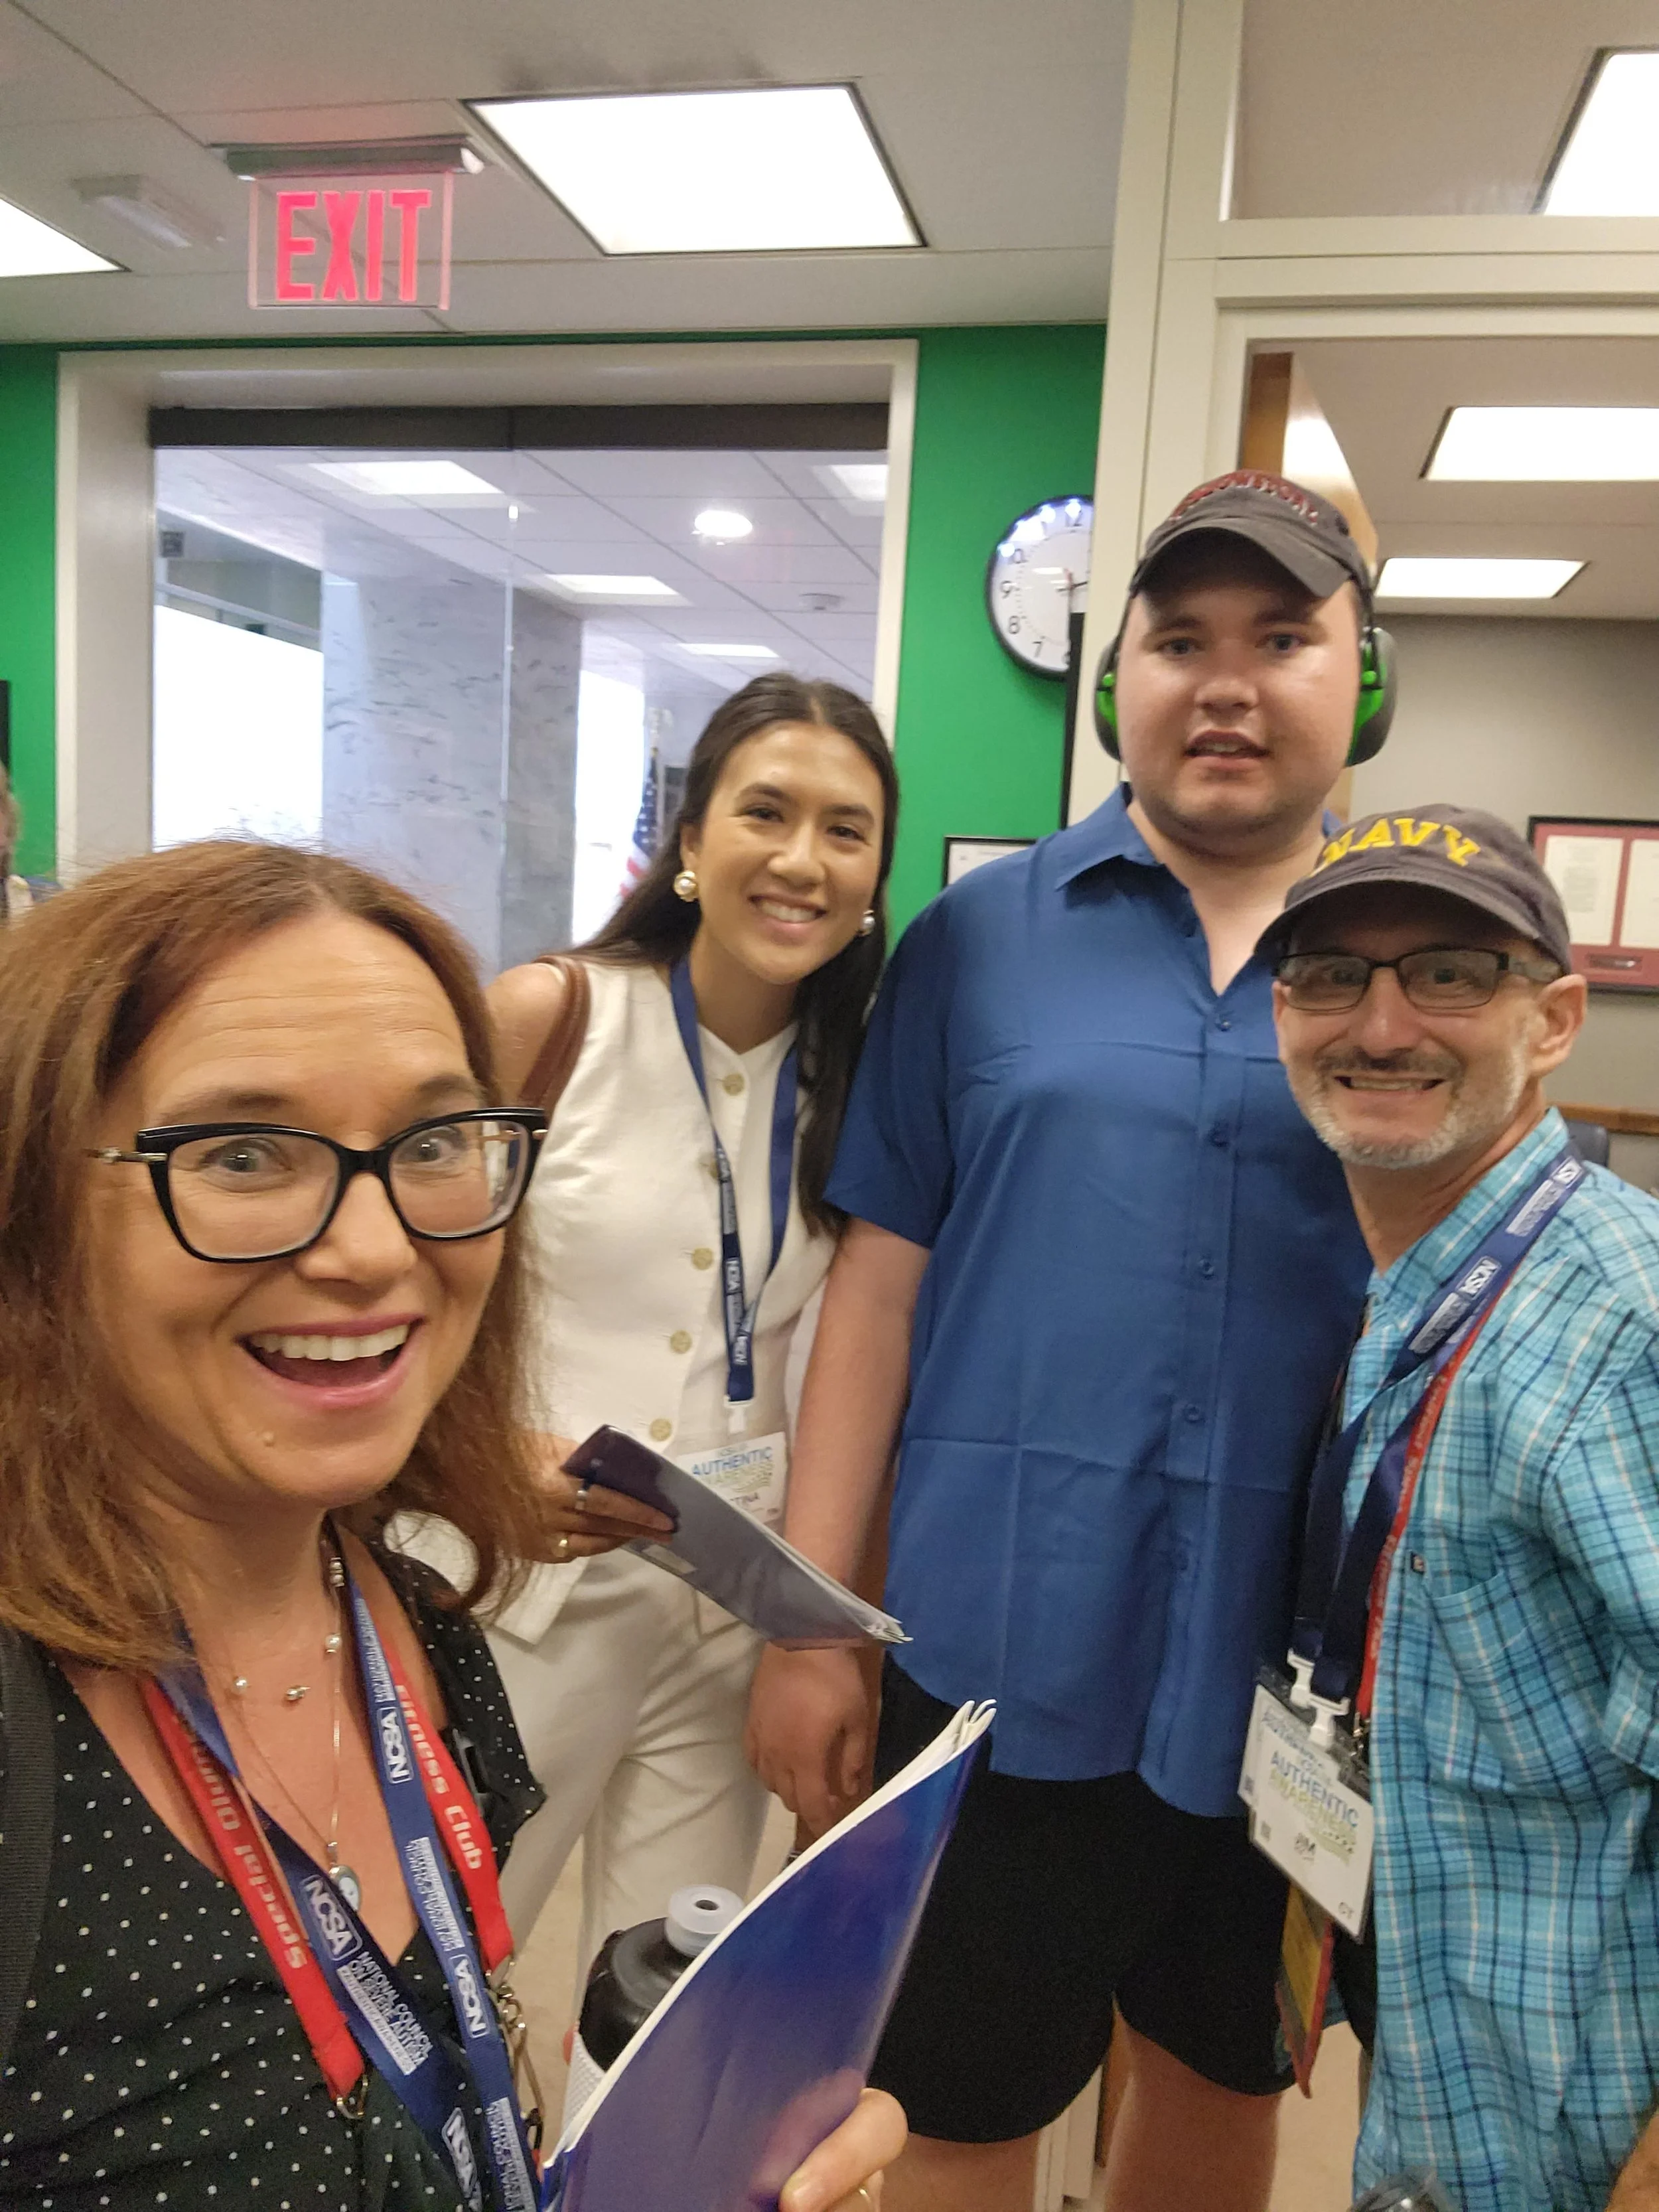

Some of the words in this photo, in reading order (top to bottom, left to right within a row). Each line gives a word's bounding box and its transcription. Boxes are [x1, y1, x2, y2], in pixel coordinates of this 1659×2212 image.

[276, 190, 432, 301] EXIT
[1008, 615, 1021, 634] 8
[1033, 640, 1043, 658] 7
[1309, 818, 1481, 877] NAVY
[691, 1446, 773, 1475] AUTHENTIC
[395, 1684, 450, 1795] Fitness
[445, 1805, 483, 1869] Club
[1271, 1750, 1359, 1827] AUTHENTIC
[233, 1844, 308, 1970] Special
[305, 1880, 353, 1955] NCSA
[356, 1950, 401, 2006] NATIONAL
[393, 2003, 434, 2057] COUNCIL
